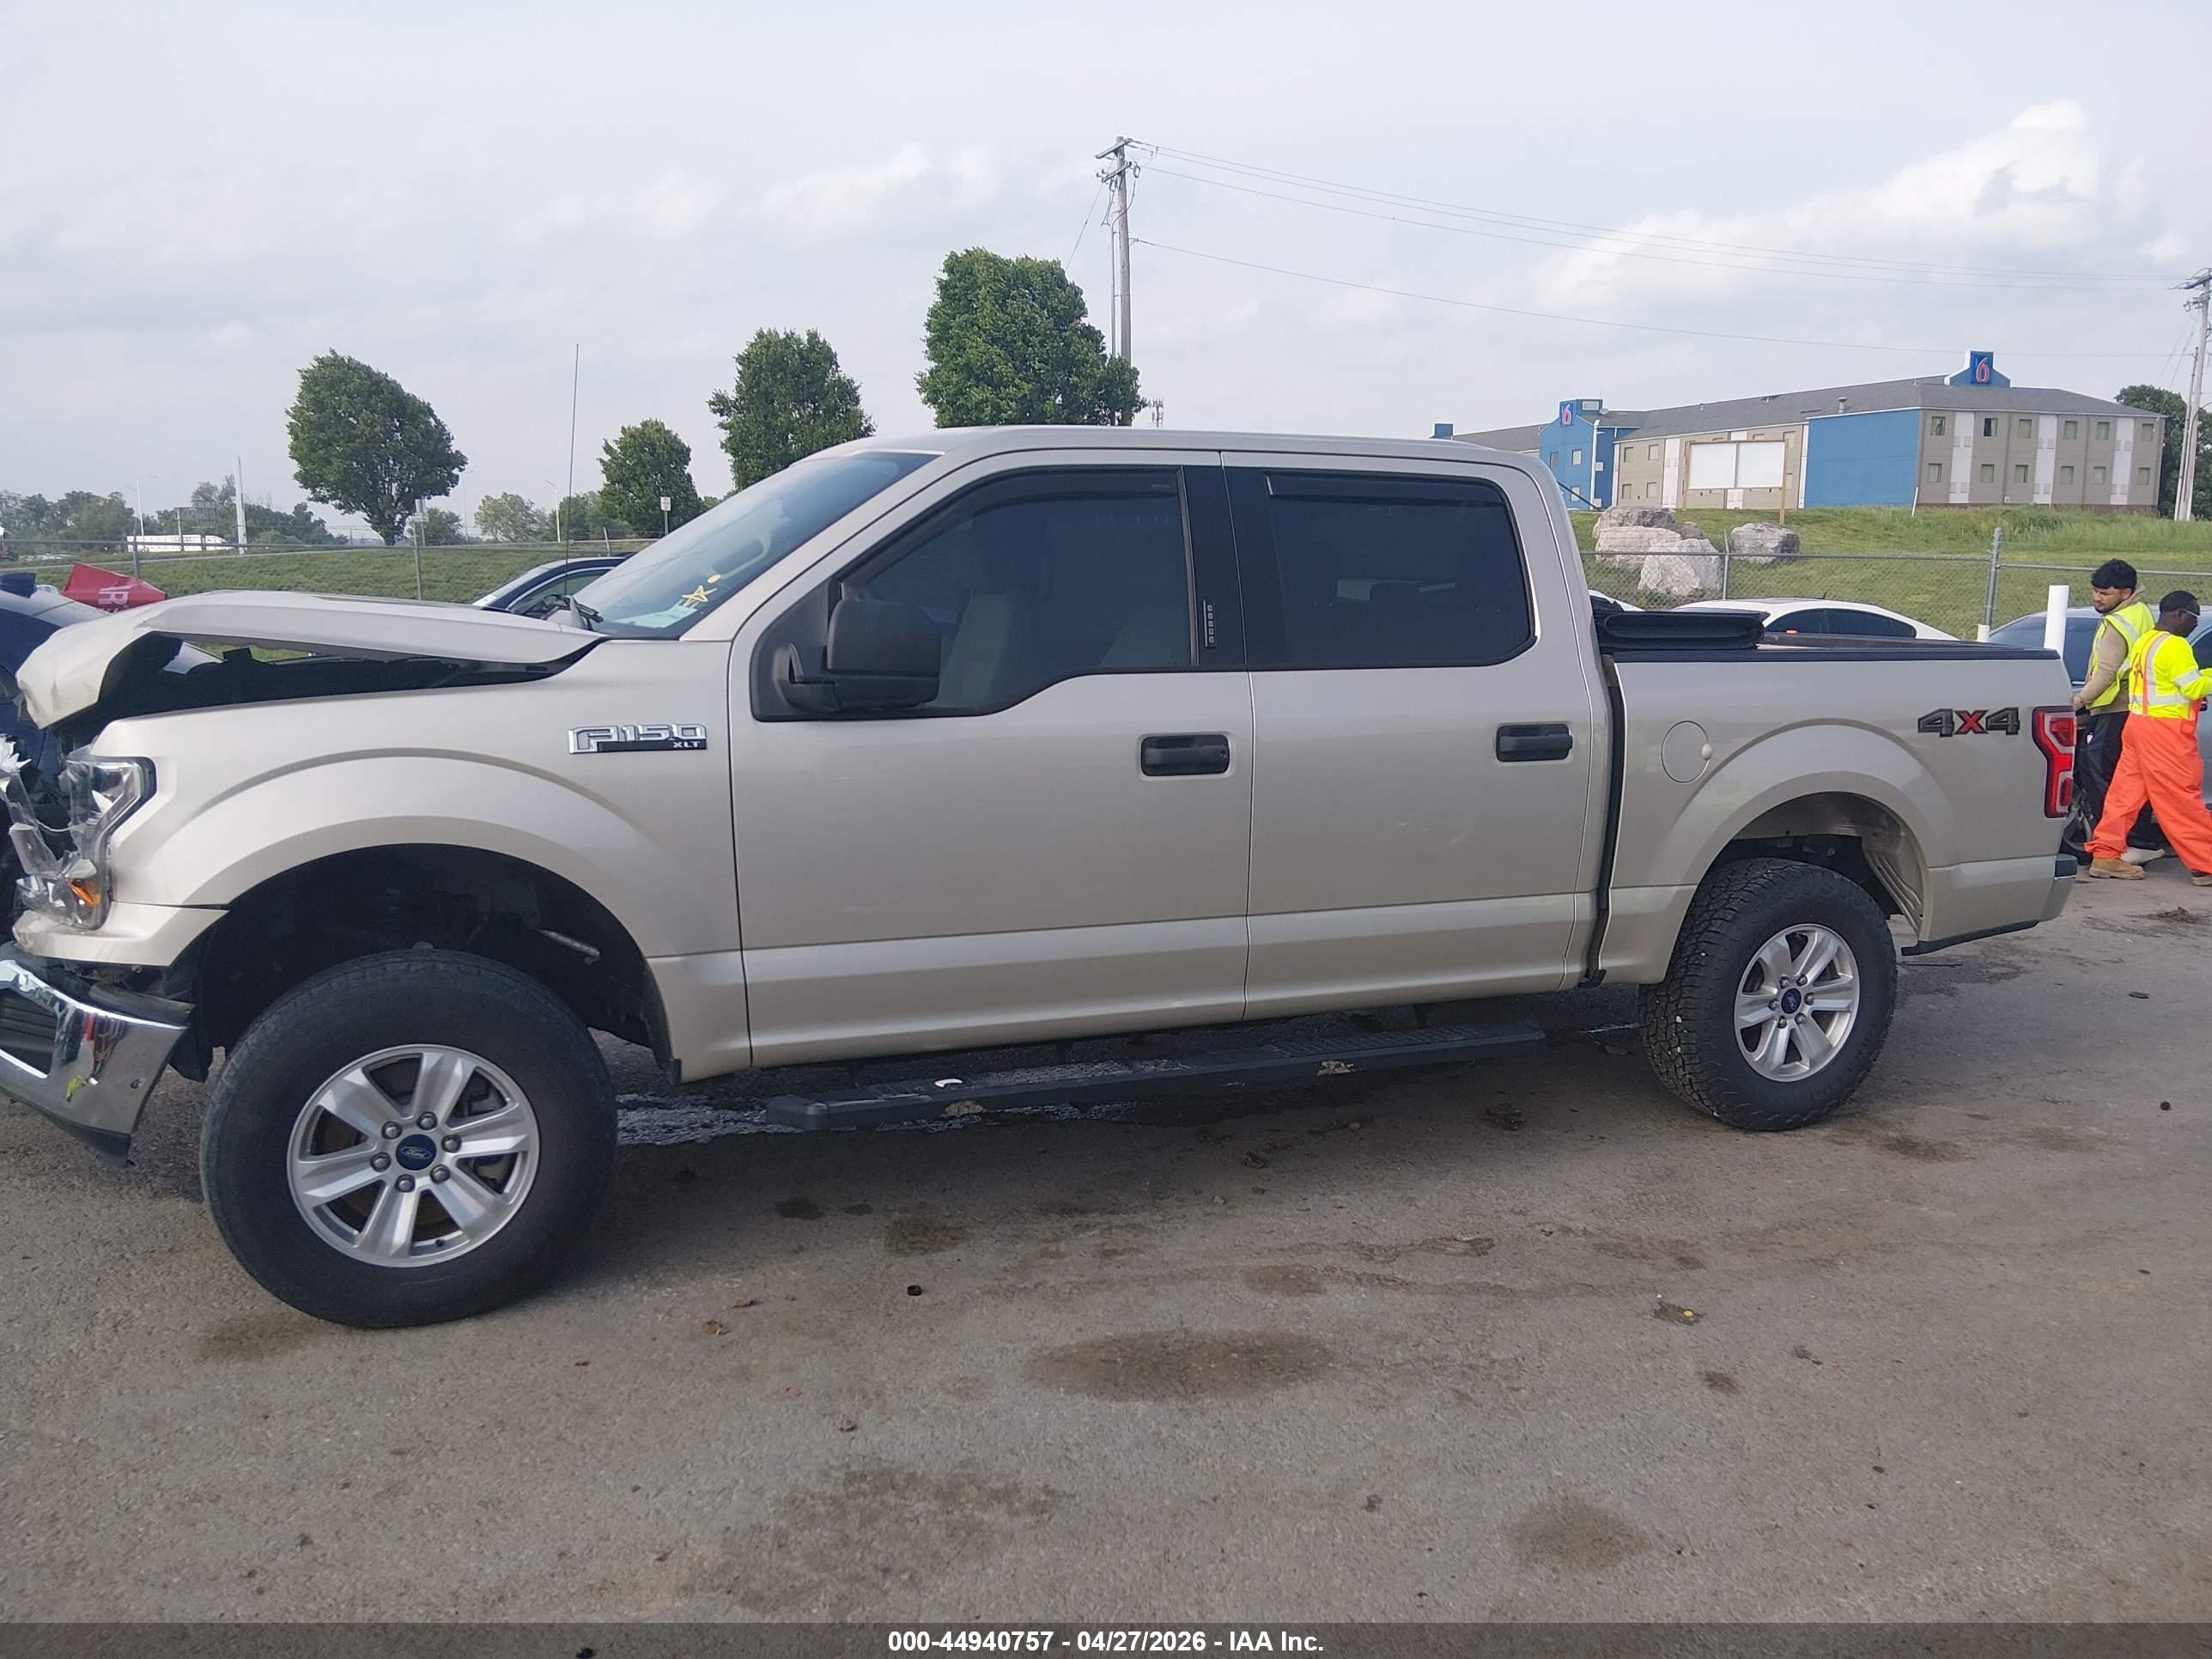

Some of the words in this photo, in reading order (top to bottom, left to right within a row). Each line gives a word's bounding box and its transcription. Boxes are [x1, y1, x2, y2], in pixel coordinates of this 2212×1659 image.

[1975, 356, 1990, 383] 6
[1561, 404, 1572, 427] 6
[672, 740, 701, 749] XLT
